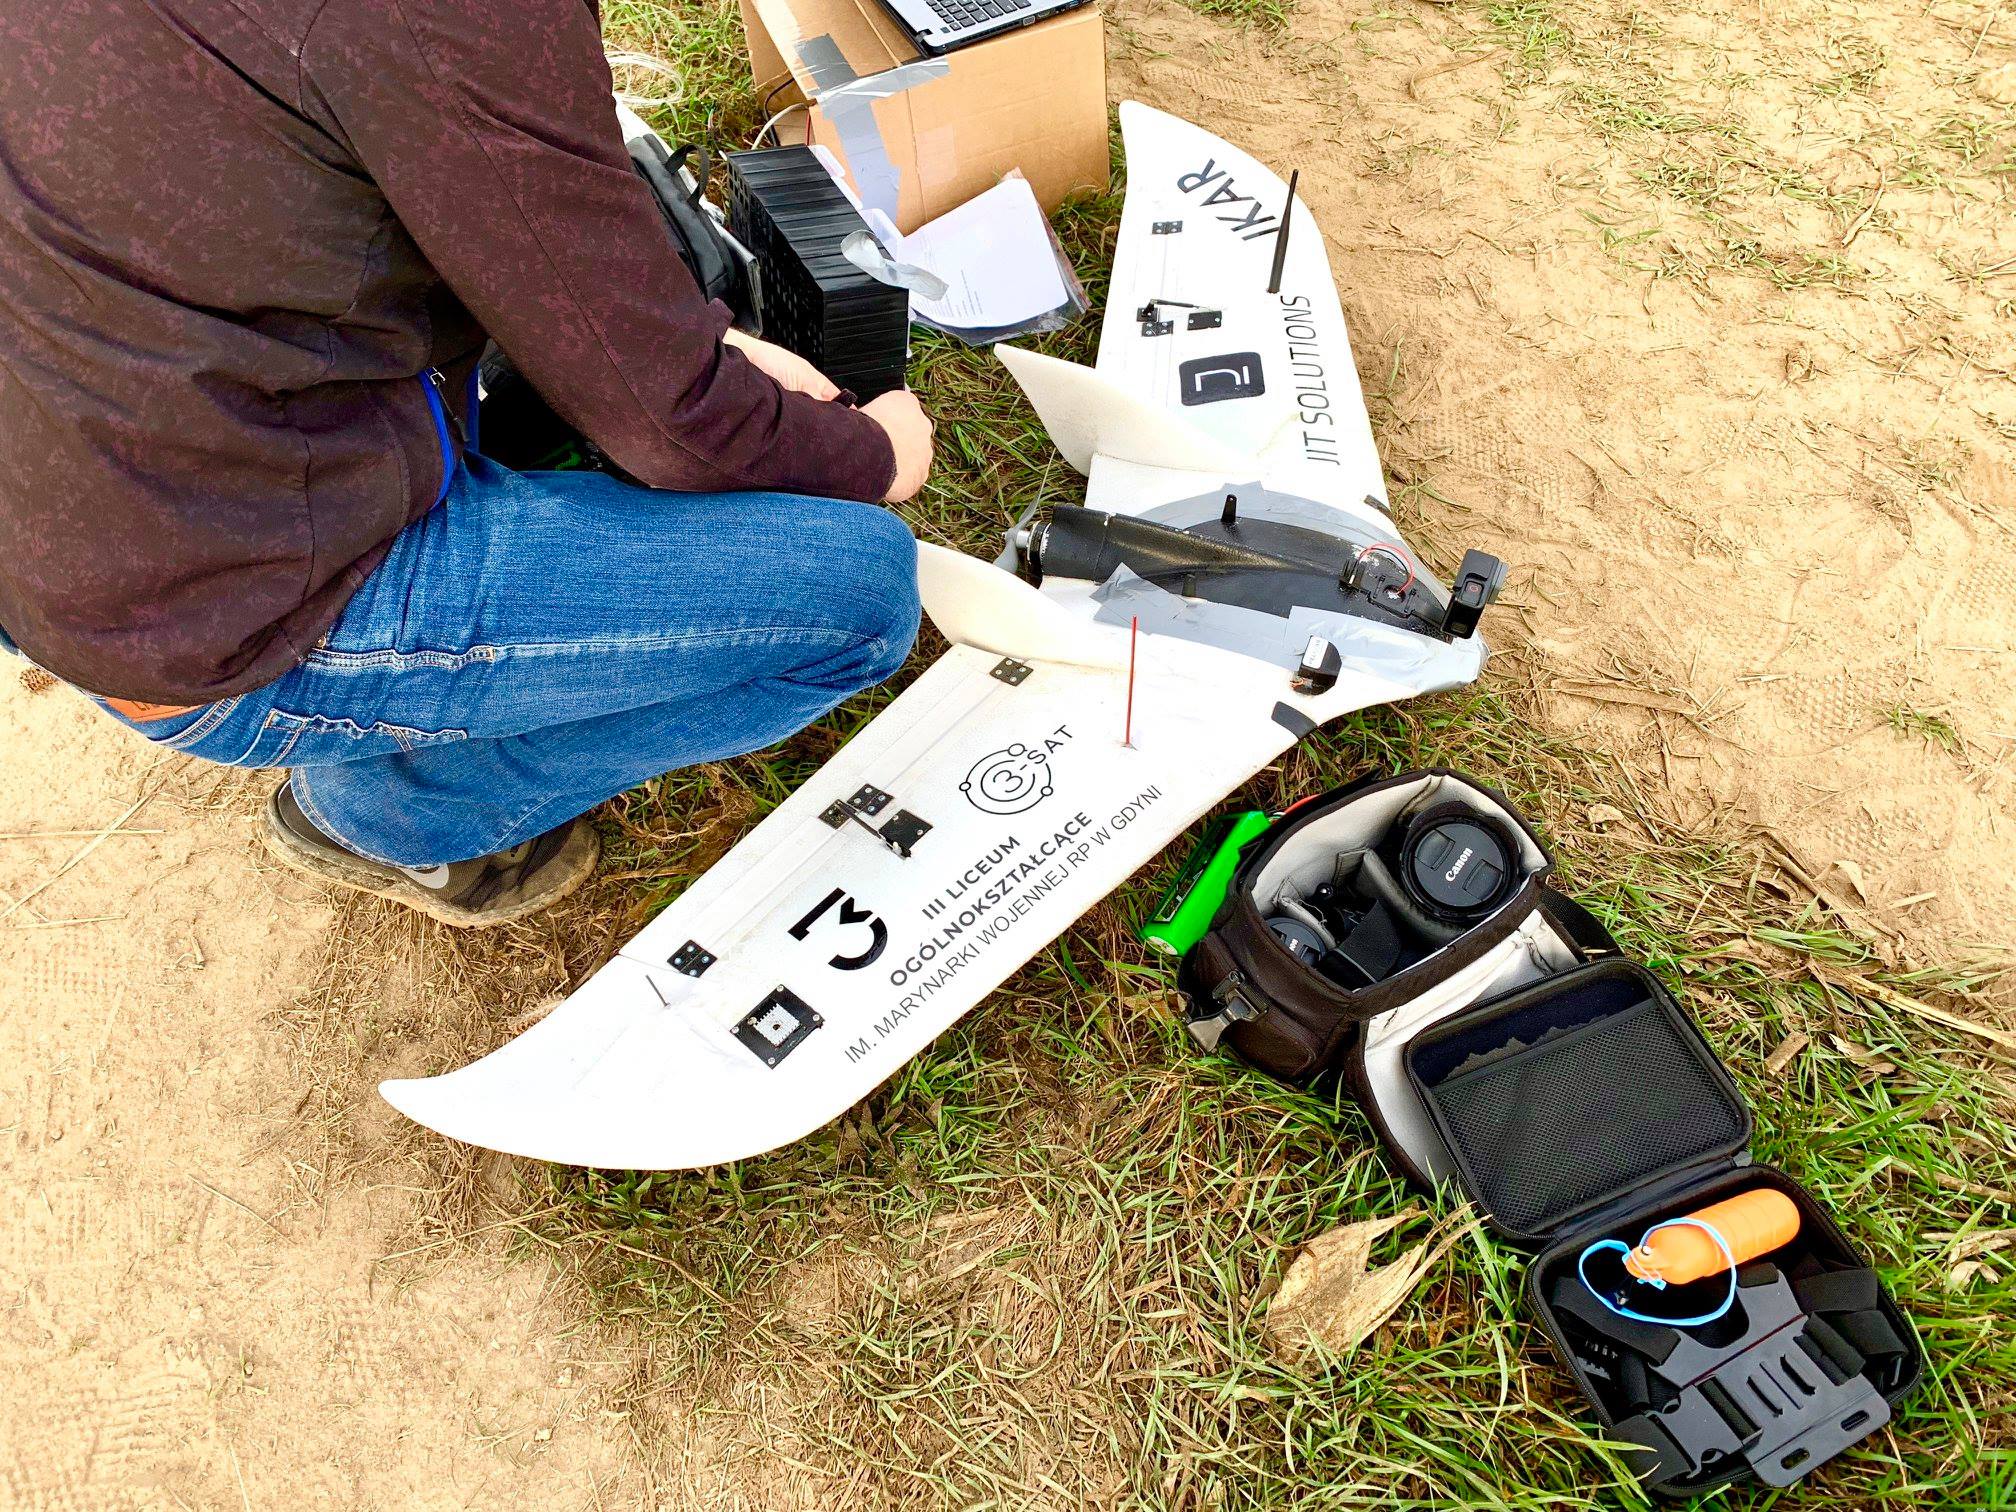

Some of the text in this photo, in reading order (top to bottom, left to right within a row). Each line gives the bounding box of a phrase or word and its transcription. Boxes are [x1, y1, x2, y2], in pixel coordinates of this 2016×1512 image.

[1177, 158, 1280, 241] IKAR
[1280, 295, 1341, 466] JIT SOLUTIONS
[993, 725, 1074, 794] 3-SAT
[890, 812, 1092, 987] OGÓLNOKSZTAŁCĄCE
[922, 836, 1021, 920] III LICEUM
[1445, 847, 1474, 882] Canon
[845, 784, 1163, 1064] IM. MARYNARKI WOJENNEJ RP W GDYNI
